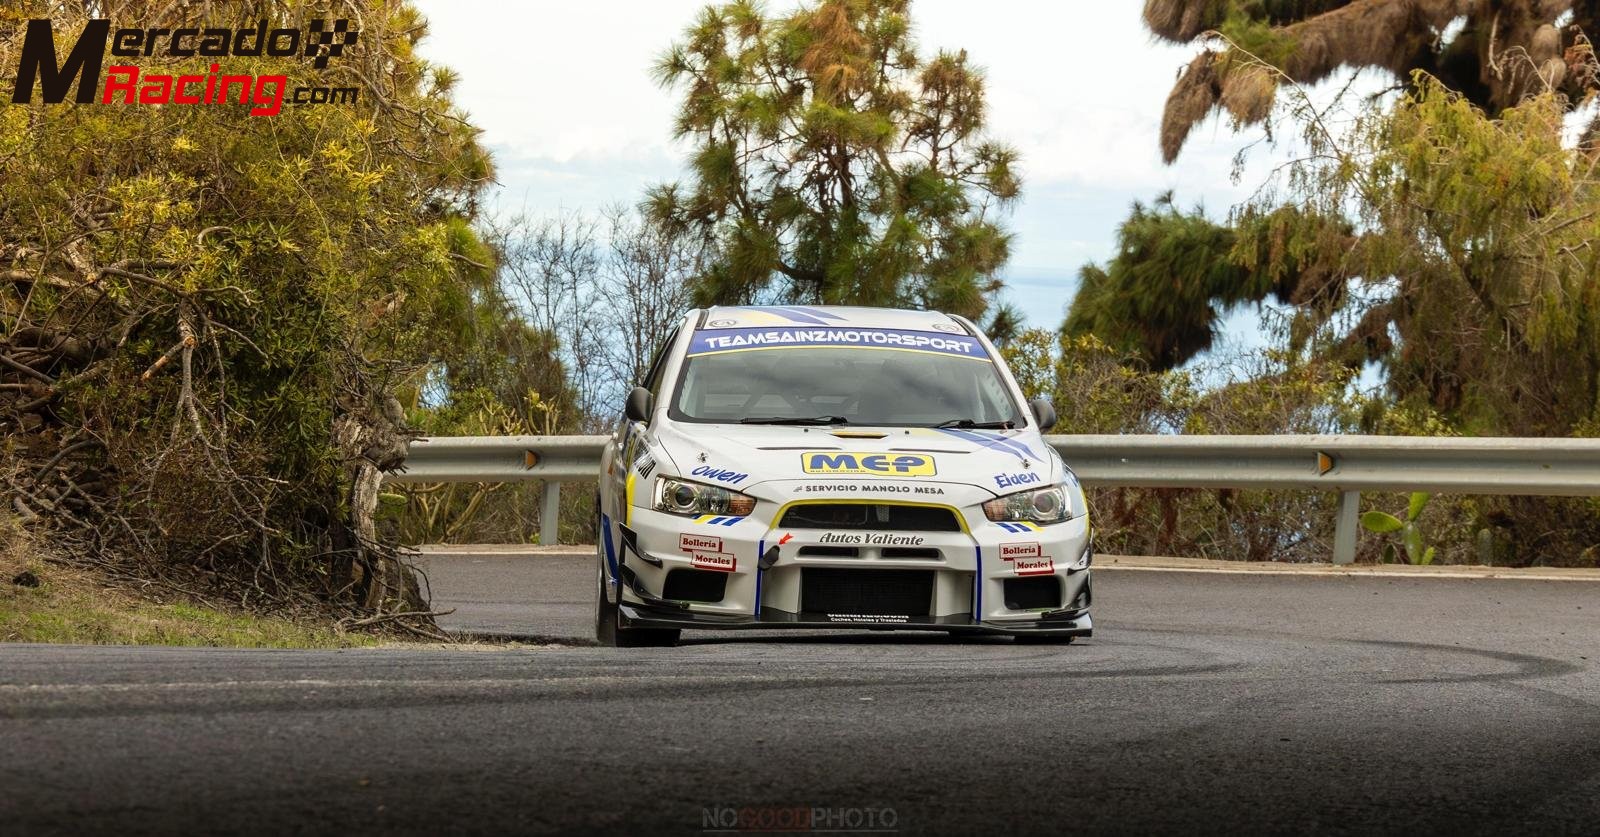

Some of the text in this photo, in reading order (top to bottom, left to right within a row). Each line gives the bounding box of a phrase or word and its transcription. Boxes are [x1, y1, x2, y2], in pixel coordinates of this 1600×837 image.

[705, 330, 972, 353] TEAMSAINZMOTORSPORT
[810, 454, 925, 473] MEP
[994, 472, 1041, 489] Eiden
[862, 485, 910, 493] MANOLO
[914, 487, 945, 495] MESA
[819, 532, 924, 546] Autos Valiente
[695, 555, 731, 565] Morales
[1017, 561, 1048, 569] Morales
